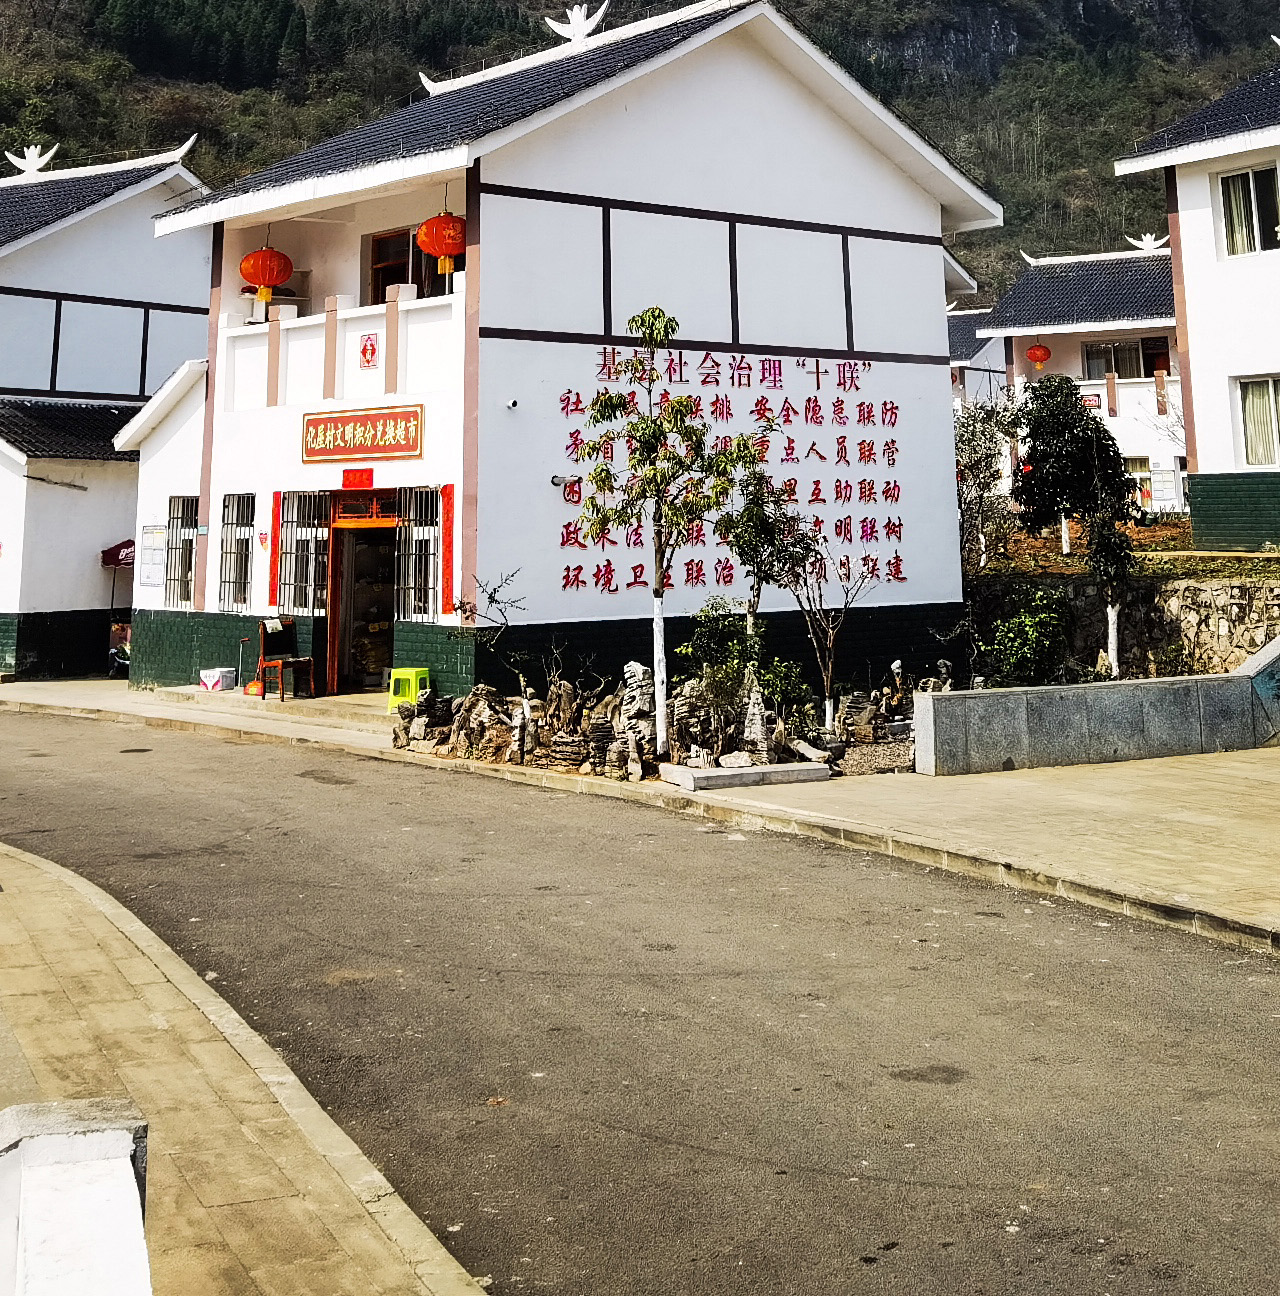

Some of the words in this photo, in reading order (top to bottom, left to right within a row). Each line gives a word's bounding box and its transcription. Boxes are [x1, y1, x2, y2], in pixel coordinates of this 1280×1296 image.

[749, 395, 899, 428] 安全隐患联防
[306, 416, 418, 450] 化屋村文明积分兑换超市
[752, 435, 900, 468] 重点人员联管
